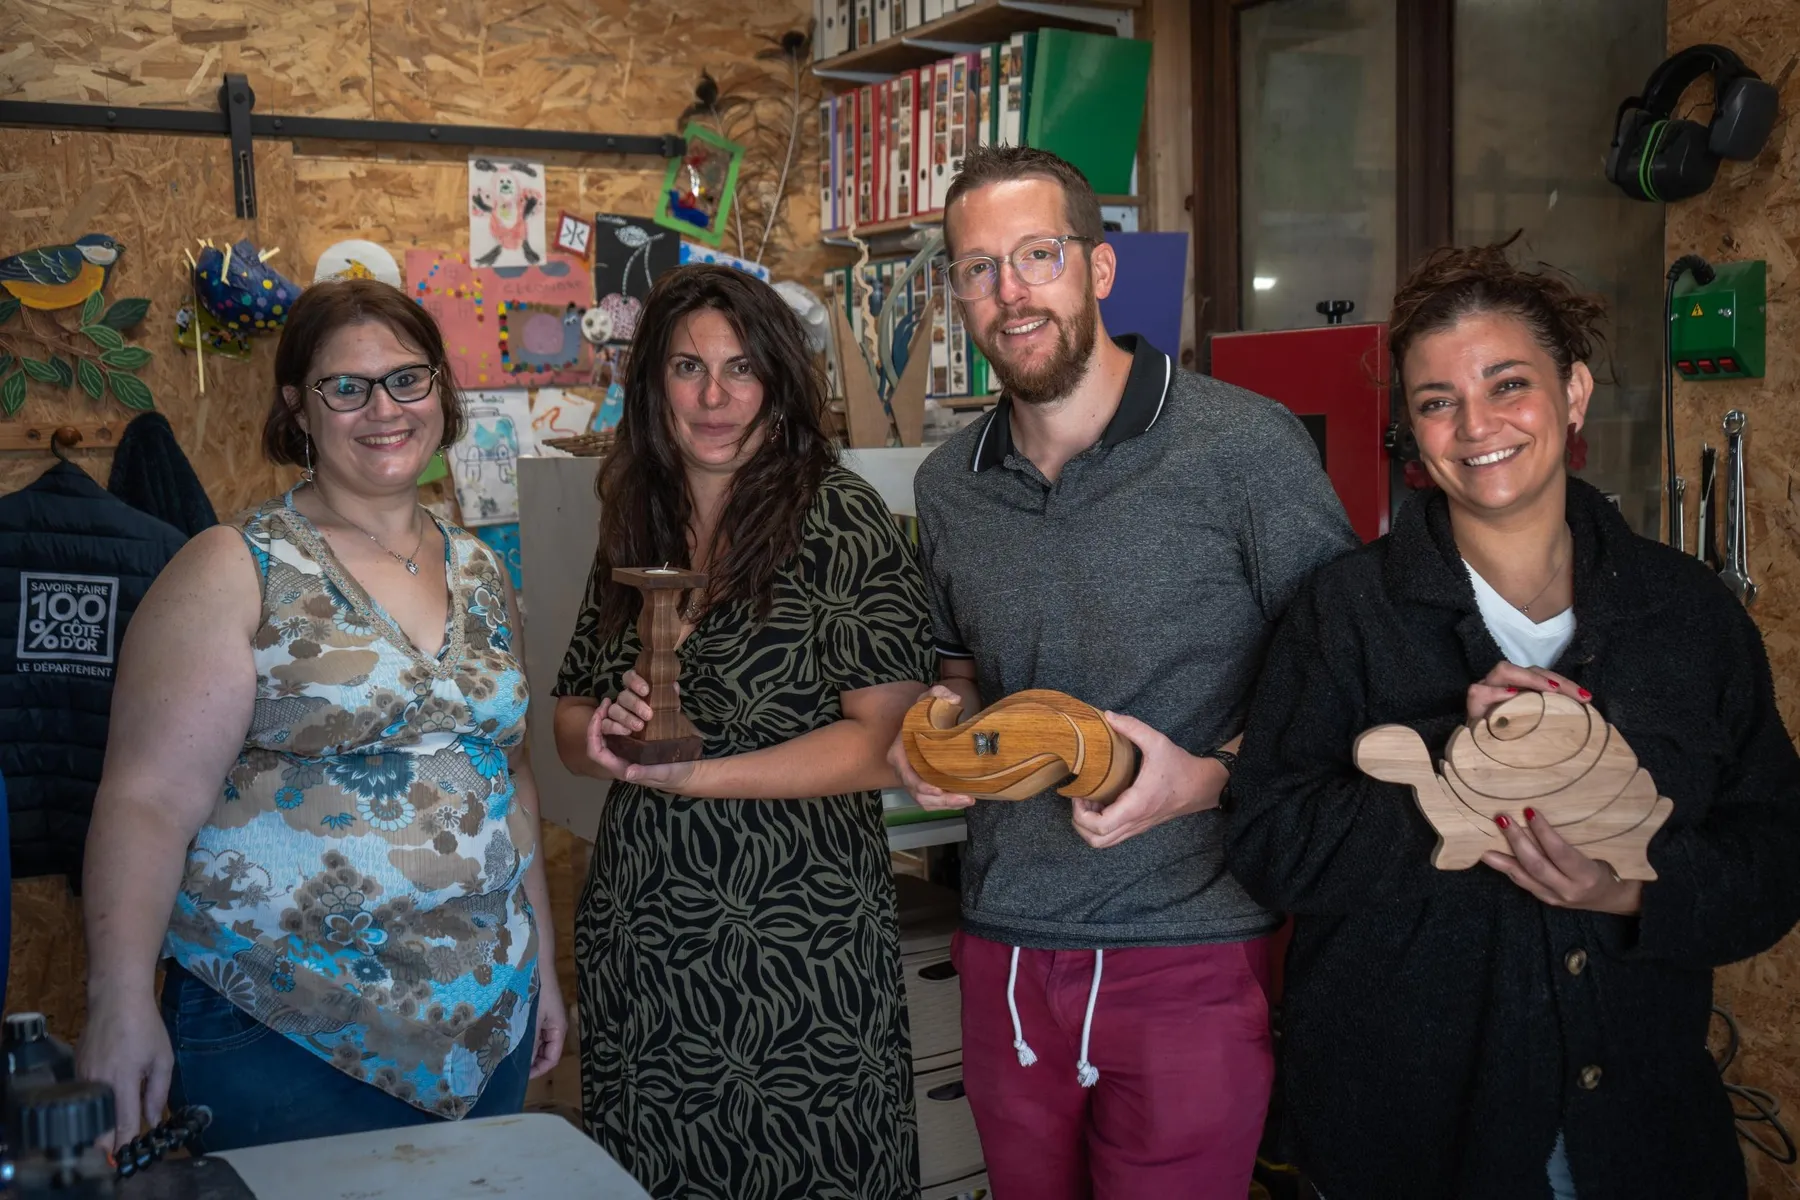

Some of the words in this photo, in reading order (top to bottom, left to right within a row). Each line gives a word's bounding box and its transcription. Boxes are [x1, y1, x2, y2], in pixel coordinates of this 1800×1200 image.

[31, 582, 108, 595] SAVOIR-FAIRE
[31, 592, 106, 623] 100
[28, 619, 59, 649] %
[61, 636, 97, 651] D'OR
[17, 663, 30, 672] LE
[33, 662, 112, 677] DÉPARTEMENT
